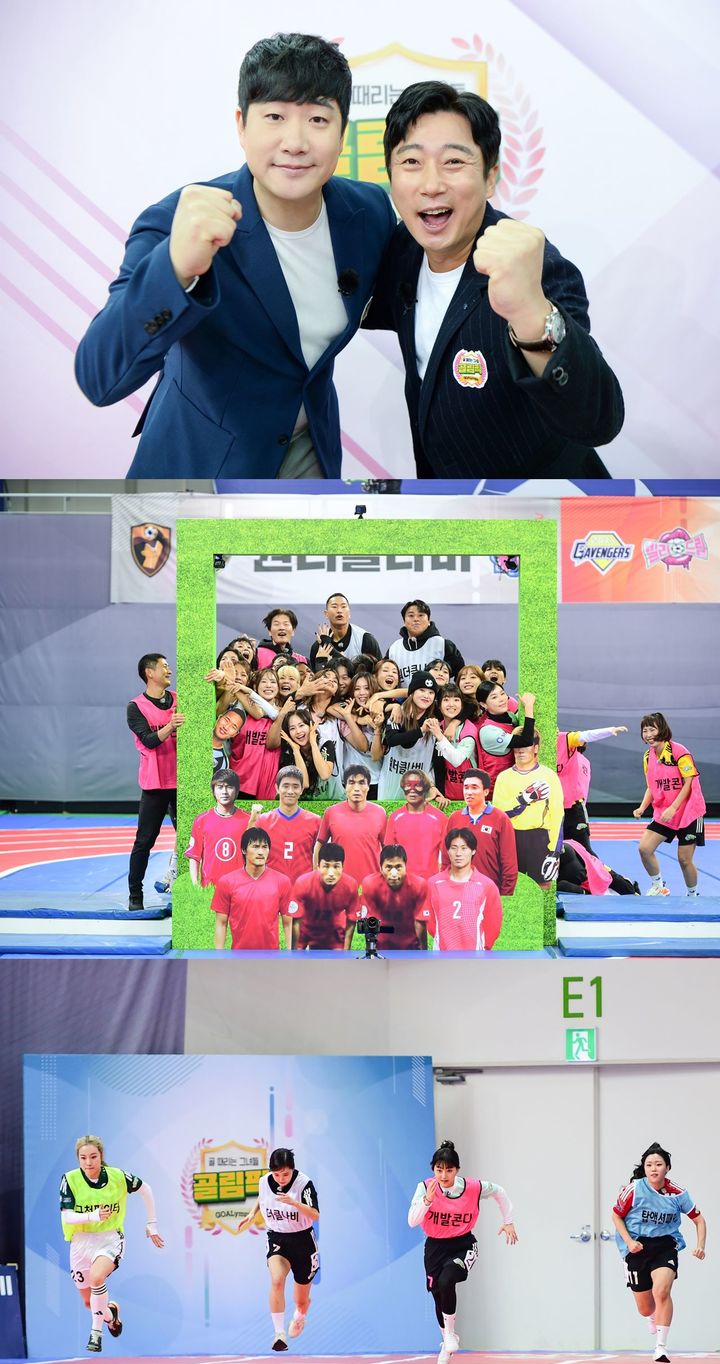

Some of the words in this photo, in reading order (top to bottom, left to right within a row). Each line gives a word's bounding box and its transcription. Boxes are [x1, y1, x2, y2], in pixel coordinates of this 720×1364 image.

[284, 842, 293, 859] 2
[452, 900, 462, 919] 2
[563, 976, 602, 1018] E1
[266, 1208, 299, 1222] 더클나비
